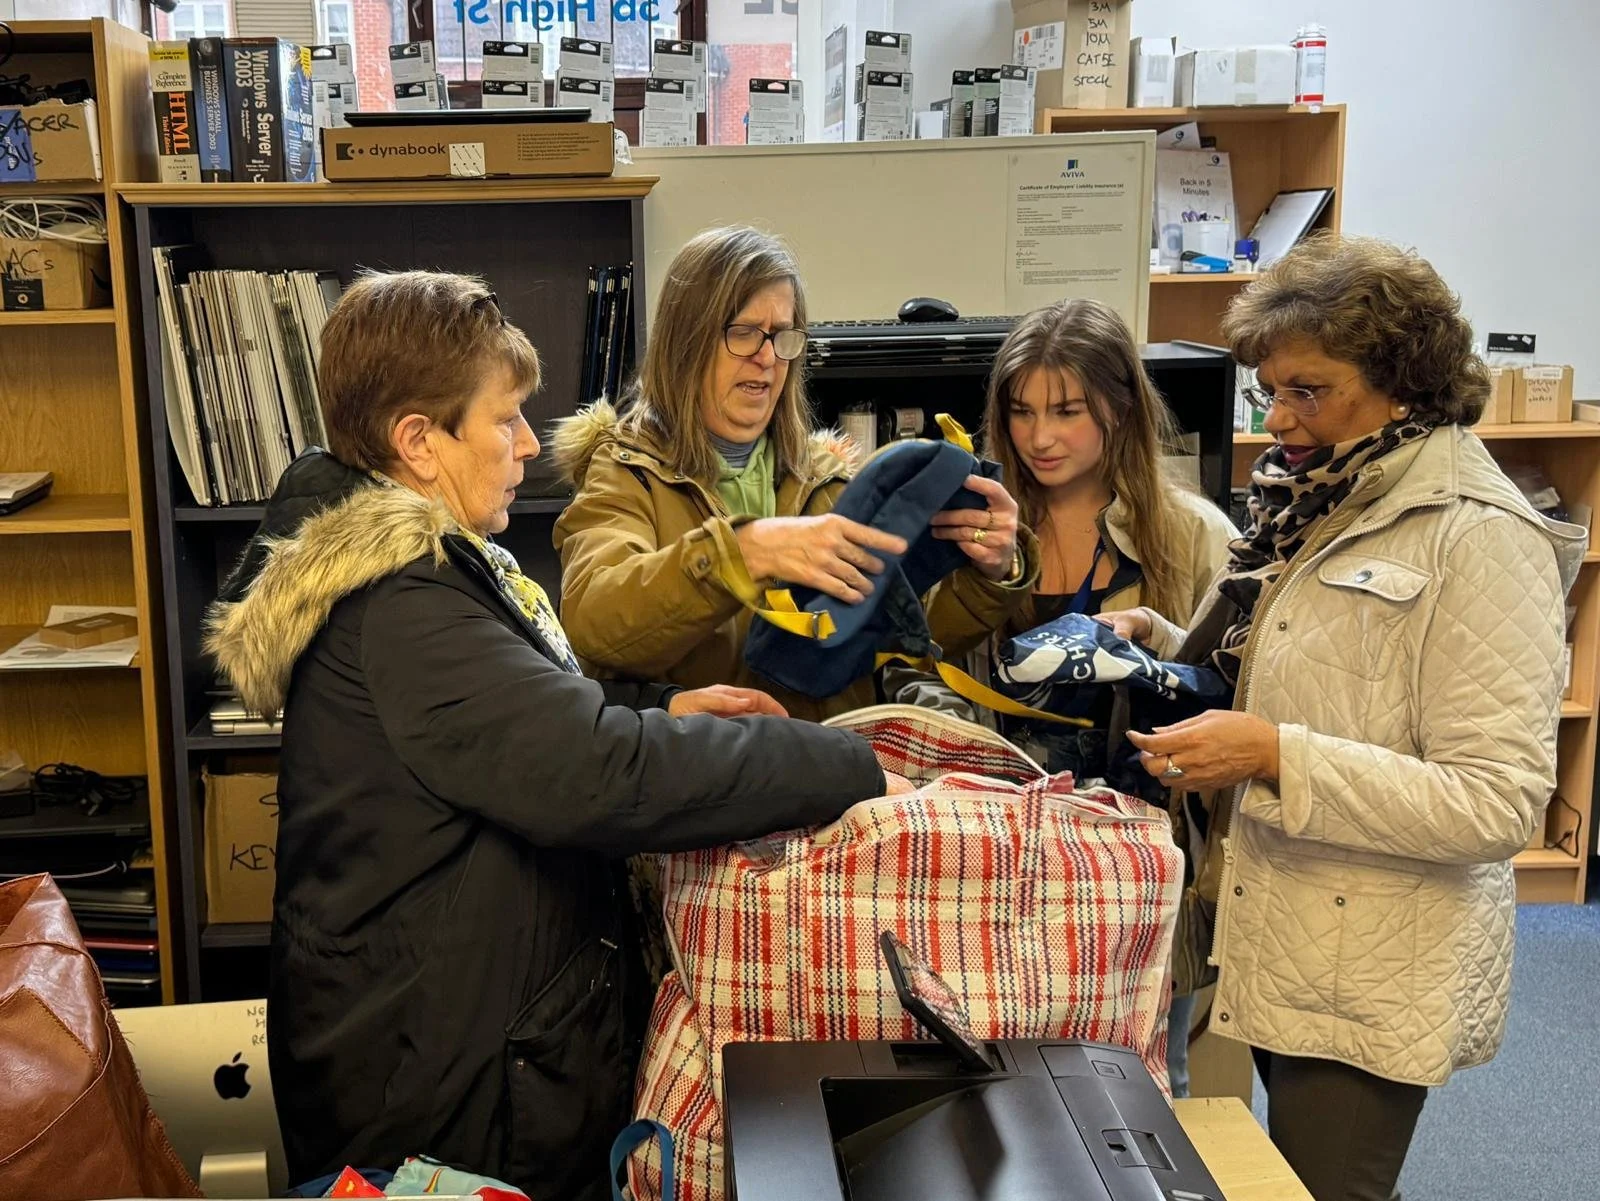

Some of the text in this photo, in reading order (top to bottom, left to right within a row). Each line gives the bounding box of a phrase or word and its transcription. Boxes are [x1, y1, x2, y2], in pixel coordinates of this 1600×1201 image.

[1091, 1, 1111, 13] 3M
[1087, 18, 1108, 29] 5M
[1085, 31, 1110, 46] 10M
[234, 50, 253, 88] 2003
[156, 80, 187, 88] Reference
[159, 73, 187, 82] Complete
[252, 50, 270, 108] Windows
[203, 70, 212, 104] BUSINESS
[211, 70, 222, 133] WINDOWS SMALL
[168, 91, 191, 154] HTML
[206, 104, 215, 130] SERVER
[257, 113, 274, 156] Server
[369, 142, 446, 157] dynabook
[1180, 177, 1197, 186] Back
[1182, 187, 1210, 196] Minutes
